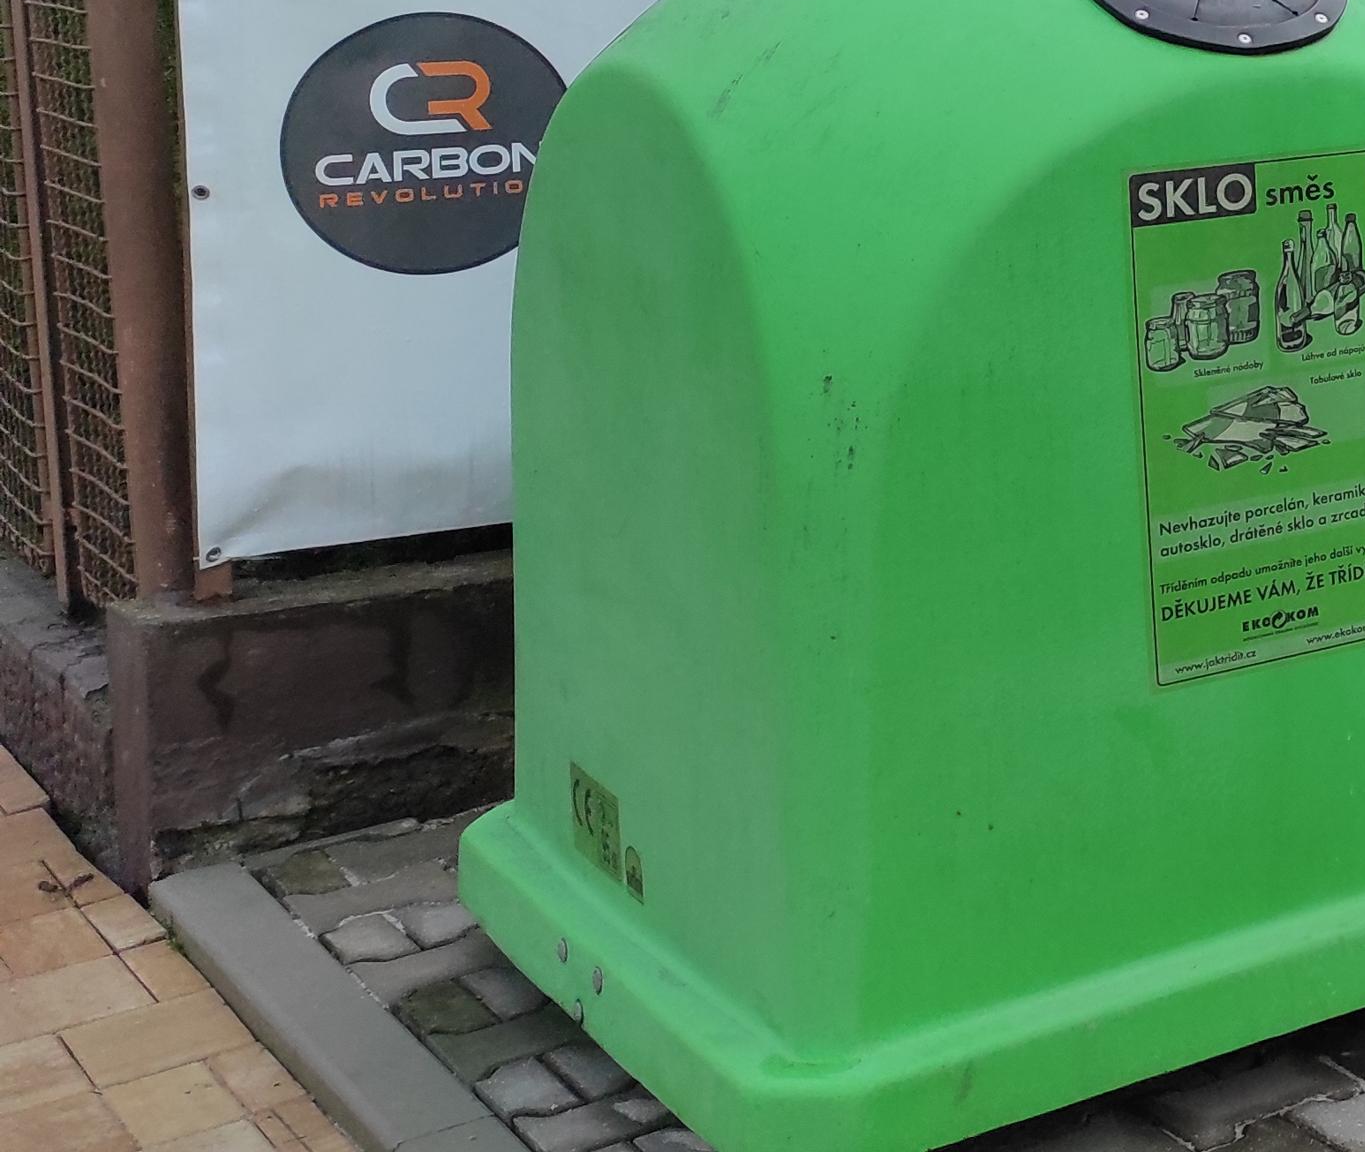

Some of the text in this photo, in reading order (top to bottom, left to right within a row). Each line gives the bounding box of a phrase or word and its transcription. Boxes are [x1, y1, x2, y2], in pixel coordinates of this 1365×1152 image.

[369, 59, 493, 136] CR
[318, 179, 524, 209] REVOLUTIO
[1137, 173, 1336, 221] SKLO směs
[1233, 361, 1264, 373] nádoby
[1326, 349, 1338, 358] od
[1346, 369, 1362, 379] sklo
[1159, 510, 1241, 536] Nevhazujte
[1245, 497, 1309, 523] porcelán,
[1160, 535, 1226, 558] autosklo,
[1229, 520, 1283, 544] drátěné
[1287, 515, 1314, 532] sklo
[1318, 516, 1327, 526] a
[1159, 576, 1208, 595] Tříděním
[1210, 567, 1252, 586] odpadu
[1304, 552, 1327, 568] jeho
[1329, 545, 1354, 561] další
[1160, 588, 1252, 622] DĚKUJEME
[1255, 579, 1301, 603] VÁM,
[1305, 571, 1325, 592] ŽE
[1174, 649, 1257, 674] www.jaktridit.cz
